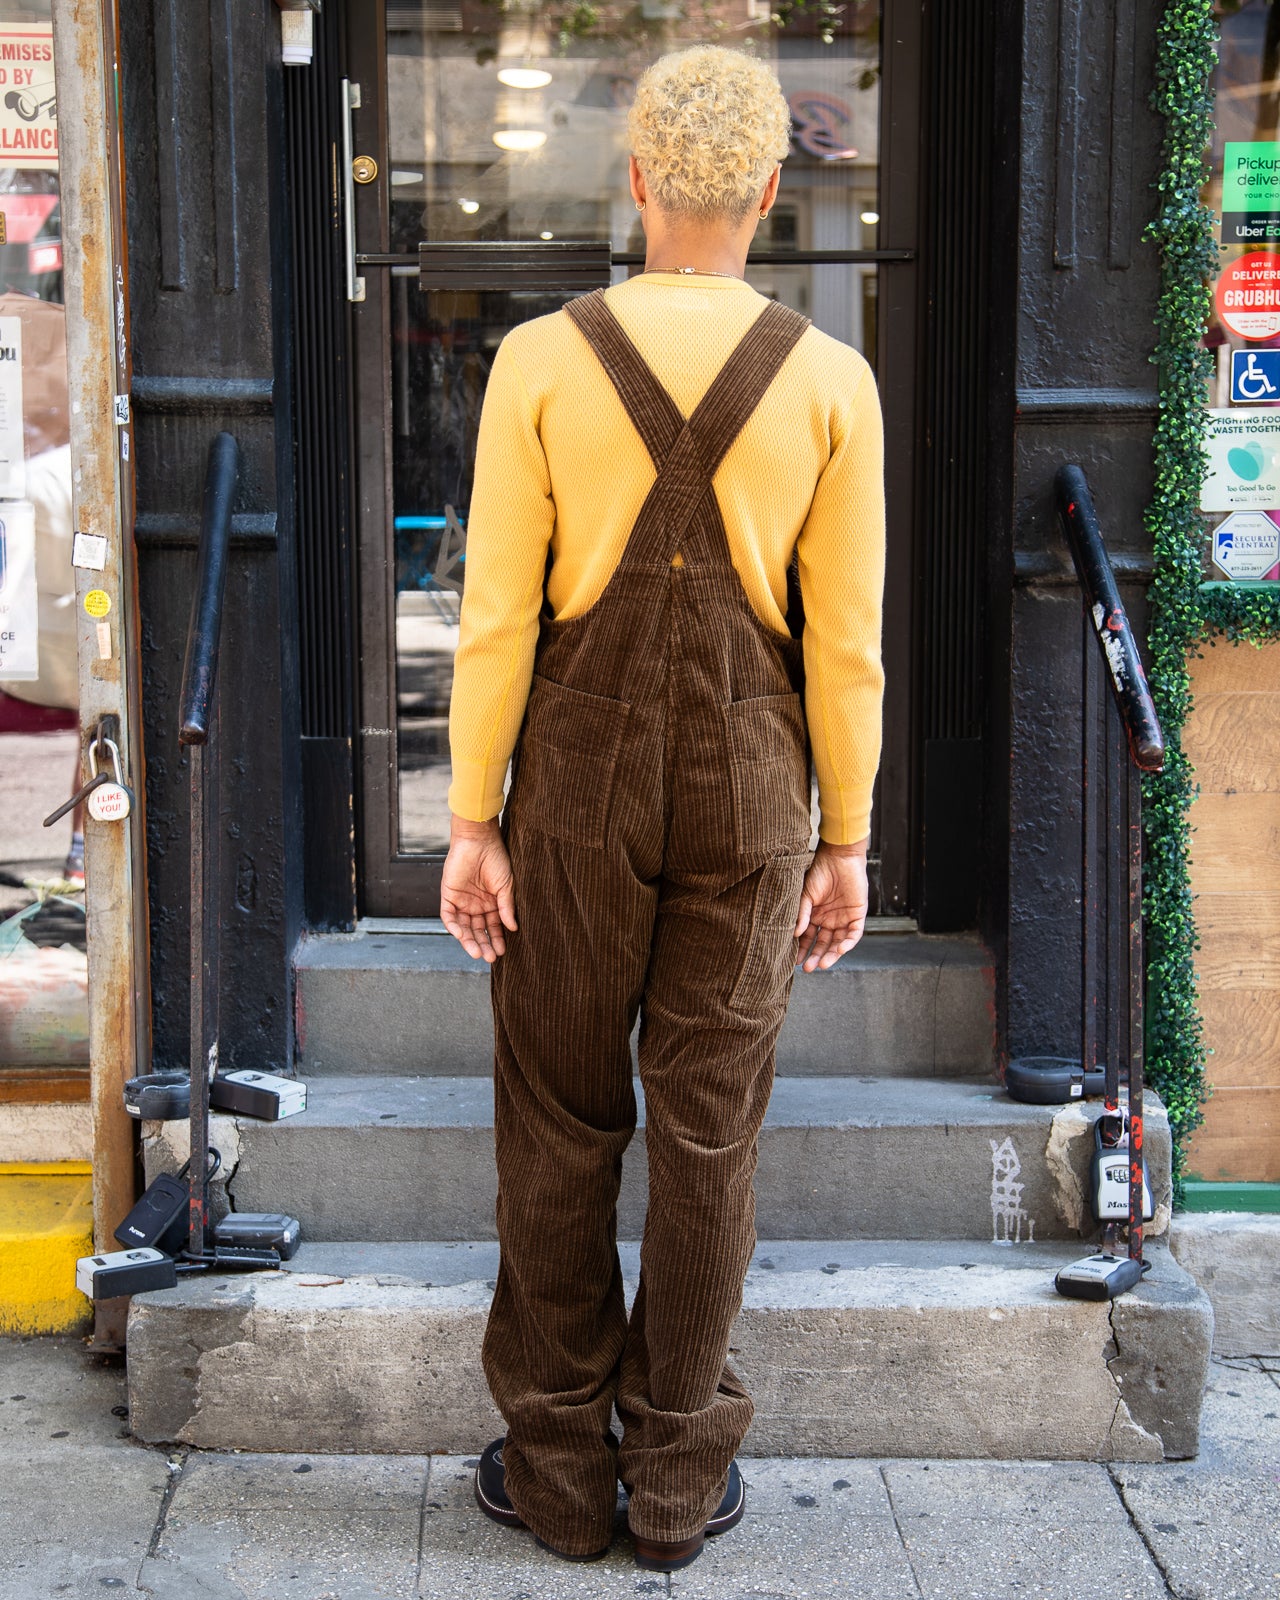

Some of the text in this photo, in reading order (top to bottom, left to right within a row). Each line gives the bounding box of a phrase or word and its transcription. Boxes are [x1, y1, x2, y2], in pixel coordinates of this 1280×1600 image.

[0, 43, 52, 61] MISES
[13, 68, 34, 85] BY
[0, 128, 58, 149] LANC
[1237, 173, 1280, 186] delive
[1235, 226, 1264, 236] Uber
[1212, 426, 1243, 434] WASTE
[102, 792, 121, 802] LIKE
[100, 803, 120, 813] YOU!
